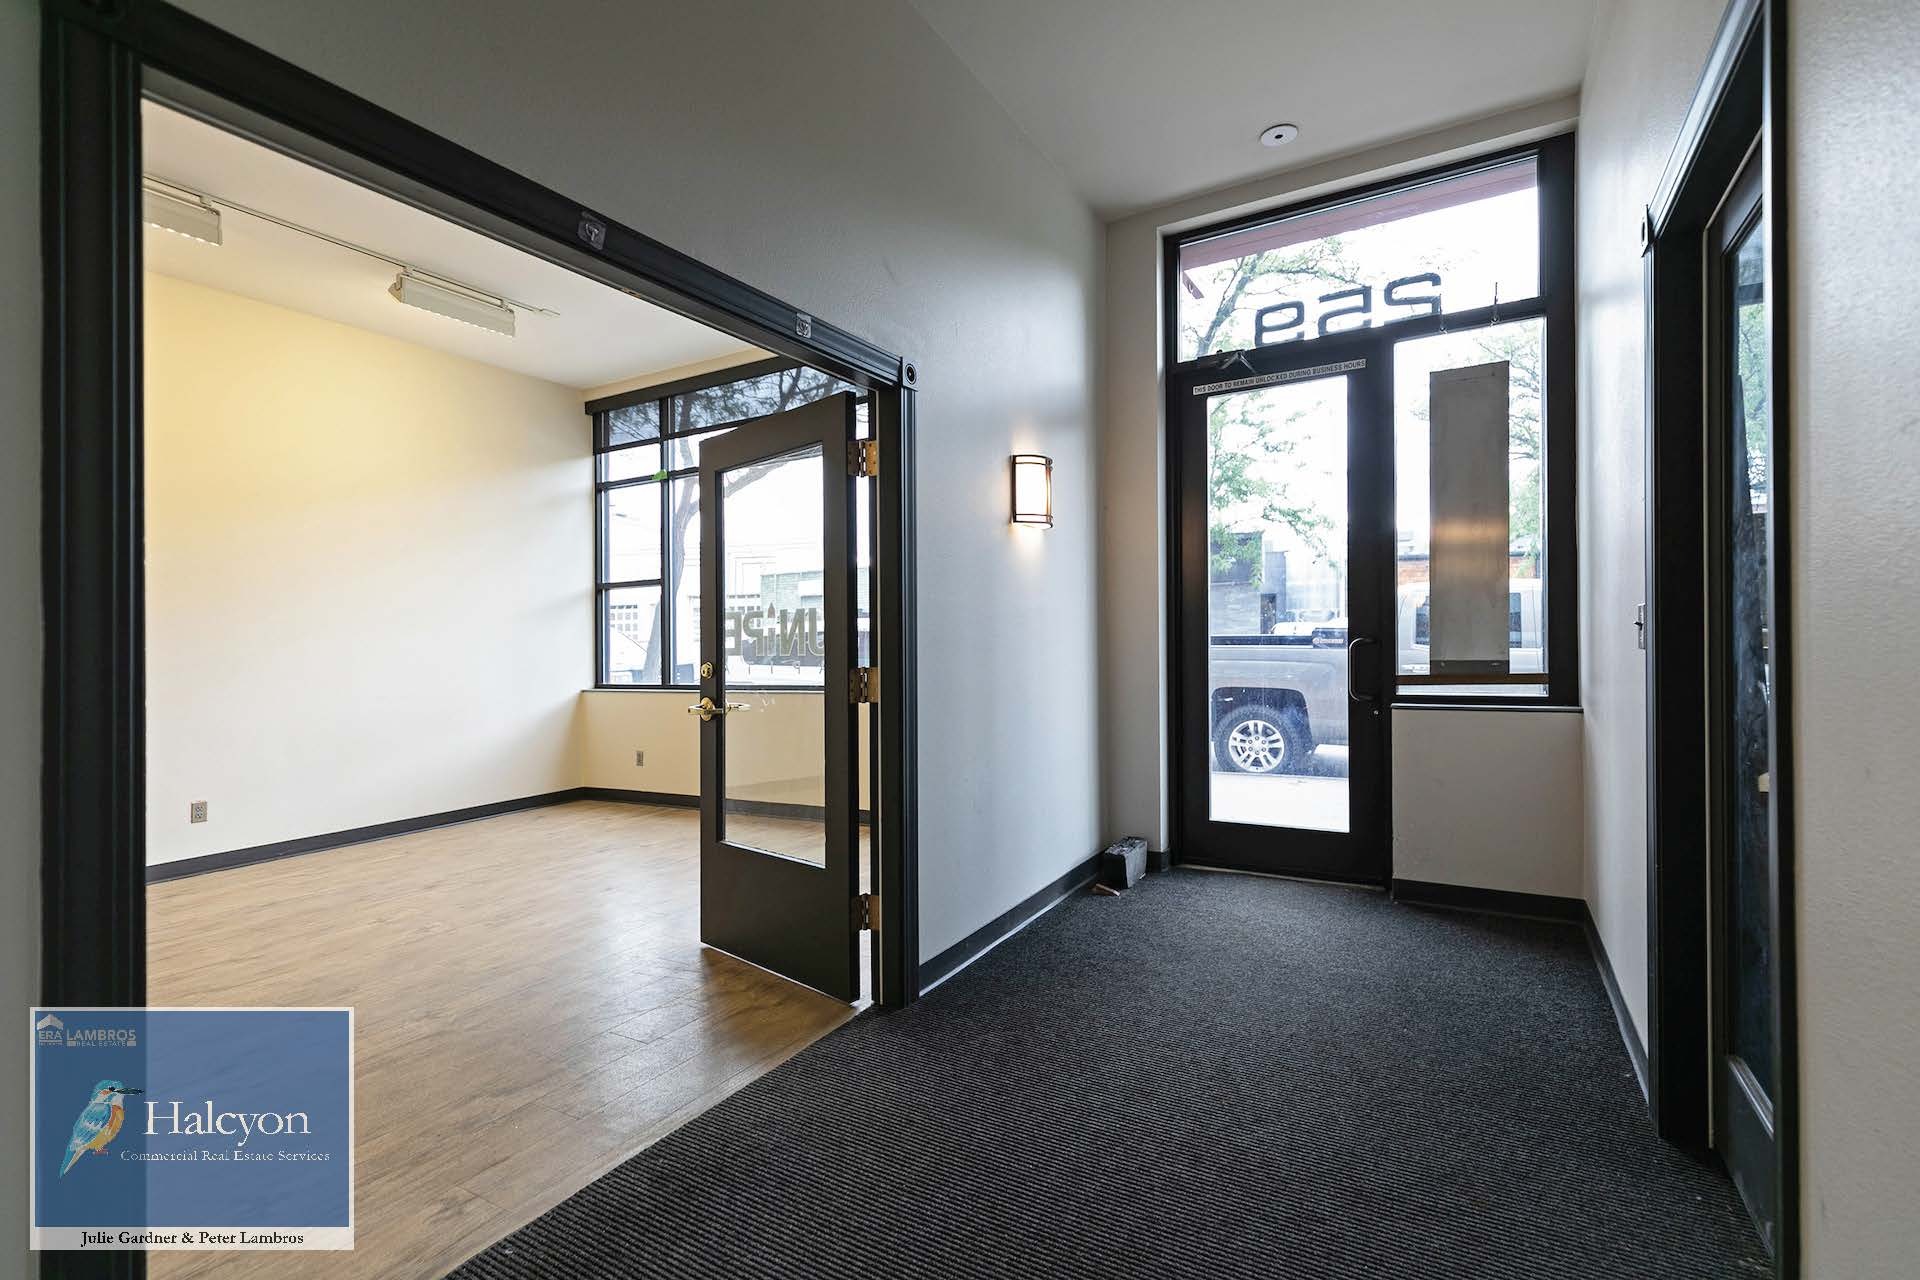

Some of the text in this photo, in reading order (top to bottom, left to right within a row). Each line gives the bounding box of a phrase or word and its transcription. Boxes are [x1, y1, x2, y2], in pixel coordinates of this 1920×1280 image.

[1194, 360, 1366, 394] THIS DOOR TO REMAIN UNLOCKED DURING BUSINESS HOURS
